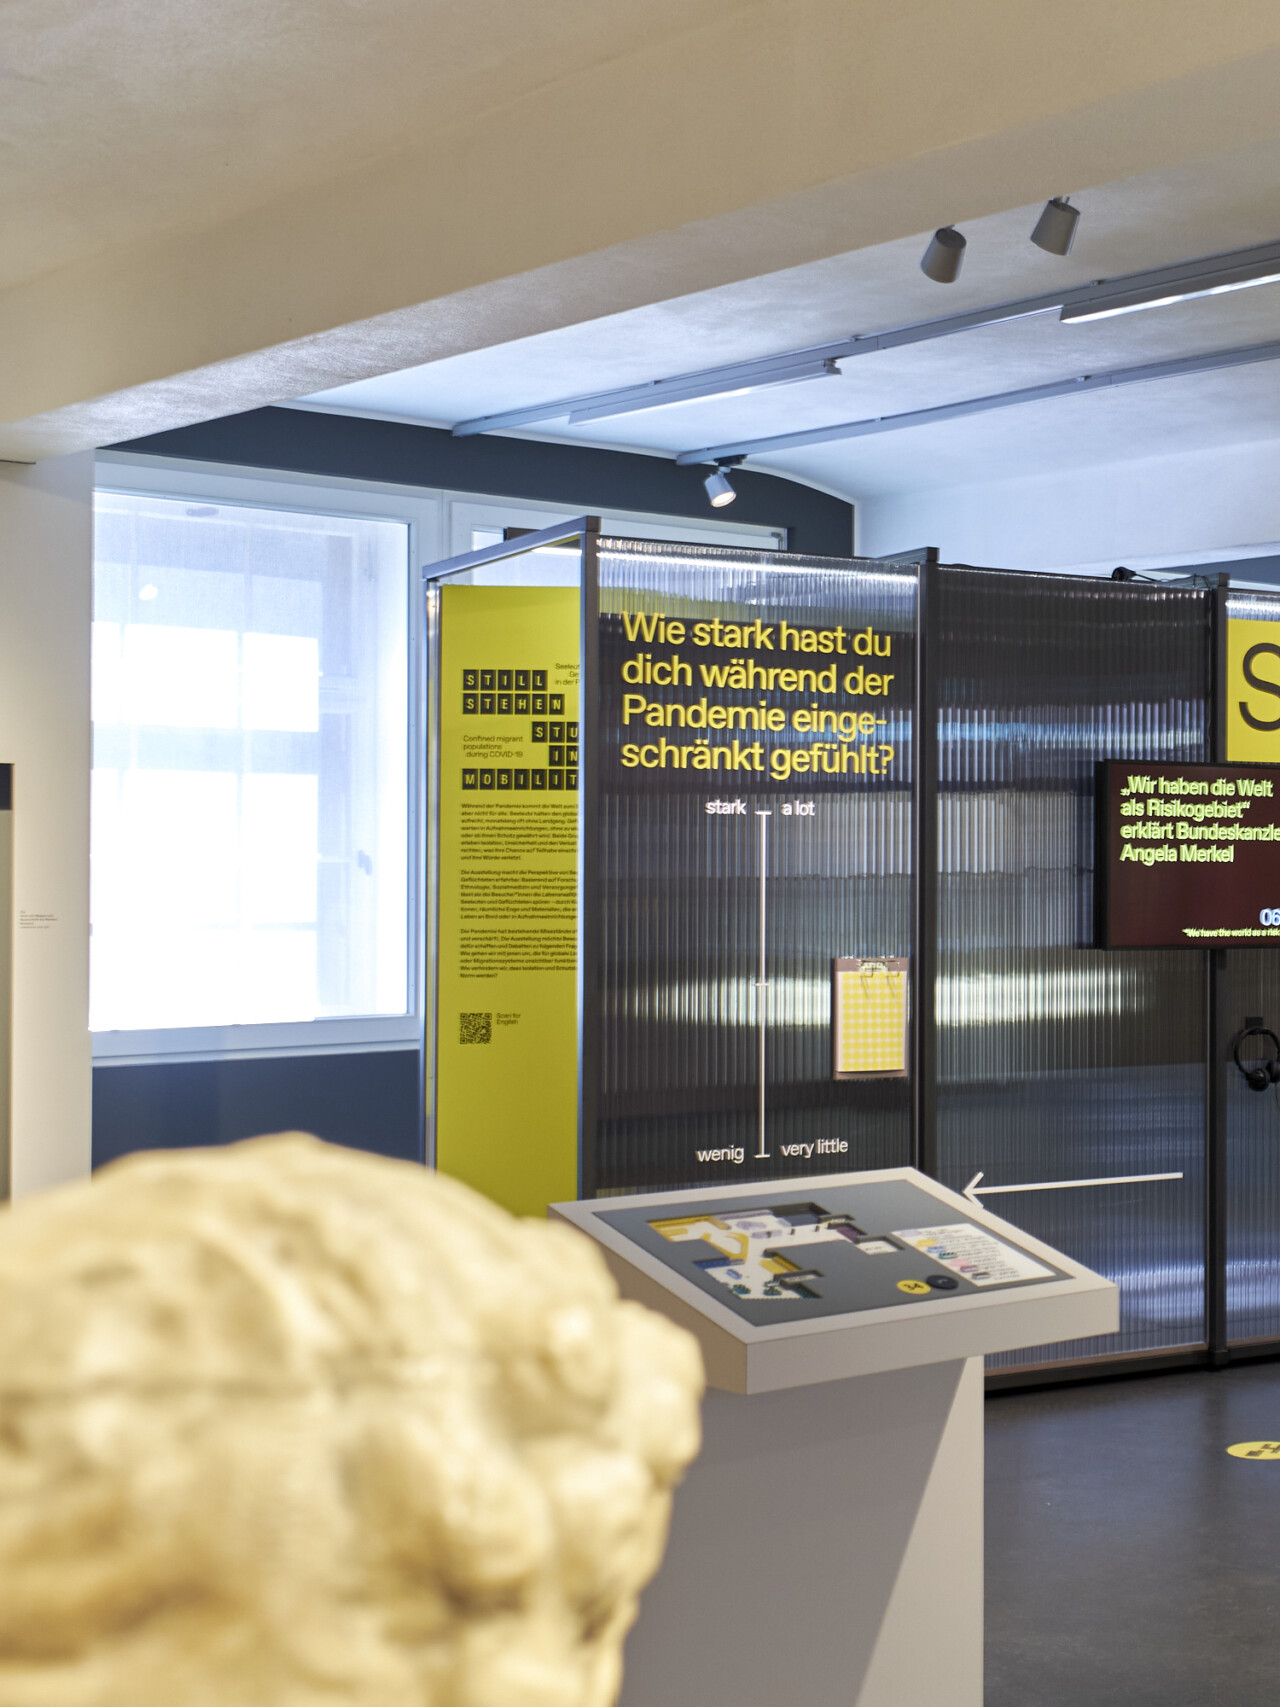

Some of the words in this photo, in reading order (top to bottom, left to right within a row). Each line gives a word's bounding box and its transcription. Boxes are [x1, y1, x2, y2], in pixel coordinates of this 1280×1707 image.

[621, 610, 686, 644] Wie
[692, 618, 774, 650] stark
[780, 621, 846, 655] hast
[852, 627, 891, 657] du
[466, 674, 543, 686] STILL
[621, 653, 693, 686] dich
[700, 659, 837, 693] während
[843, 665, 895, 696] der
[466, 698, 562, 710] STEHEN
[622, 693, 786, 732] Pandemie
[792, 703, 888, 742] einge-
[620, 738, 764, 772] schränkt
[770, 743, 895, 781] gefühlt?
[1158, 777, 1209, 796] haben
[1211, 778, 1235, 796] die
[1237, 779, 1274, 797] Welt
[704, 799, 746, 816] stark
[781, 804, 792, 816] a
[794, 800, 816, 816] lot
[1120, 798, 1144, 817] als
[1120, 820, 1174, 840] erklärt
[1120, 843, 1177, 866] Angela
[1180, 844, 1234, 864] Merkel
[1200, 928, 1218, 937] have
[1219, 928, 1231, 937] the
[1231, 928, 1251, 937] world
[1267, 928, 1280, 937] risk
[696, 1145, 746, 1165] wenig
[780, 1141, 814, 1160] very
[816, 1137, 849, 1156] little
